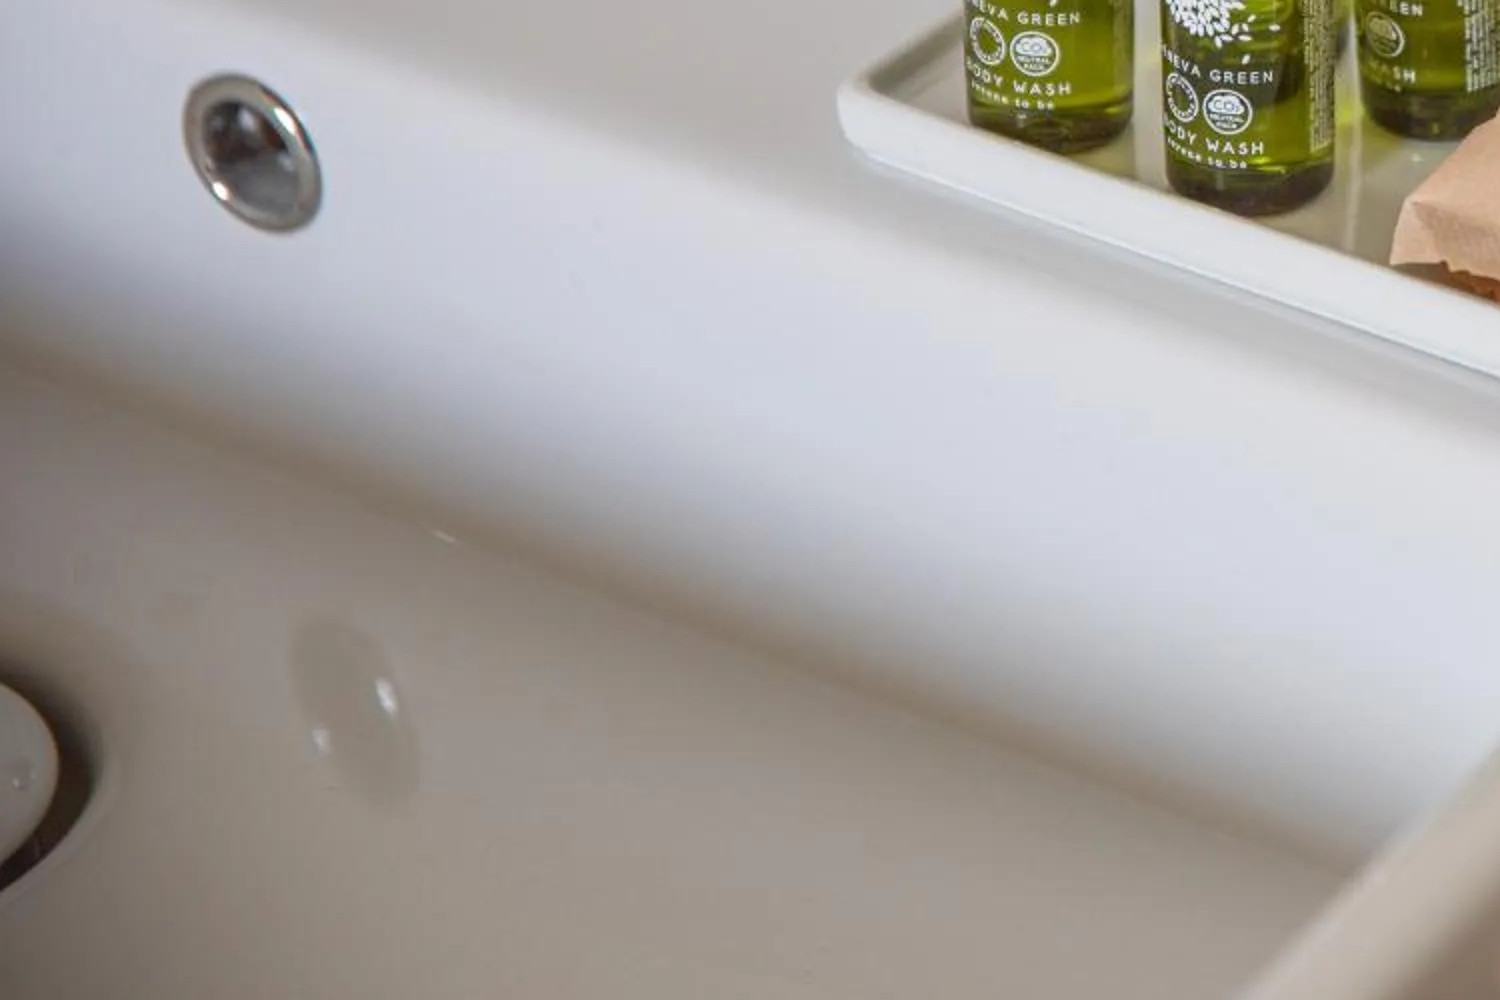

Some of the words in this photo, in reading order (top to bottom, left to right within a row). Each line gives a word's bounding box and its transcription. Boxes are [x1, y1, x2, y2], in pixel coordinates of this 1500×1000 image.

[1016, 11, 1081, 27] GREEN
[1209, 69, 1274, 86] GREEN
[1013, 79, 1072, 97] WASH
[1205, 137, 1264, 156] WASH
